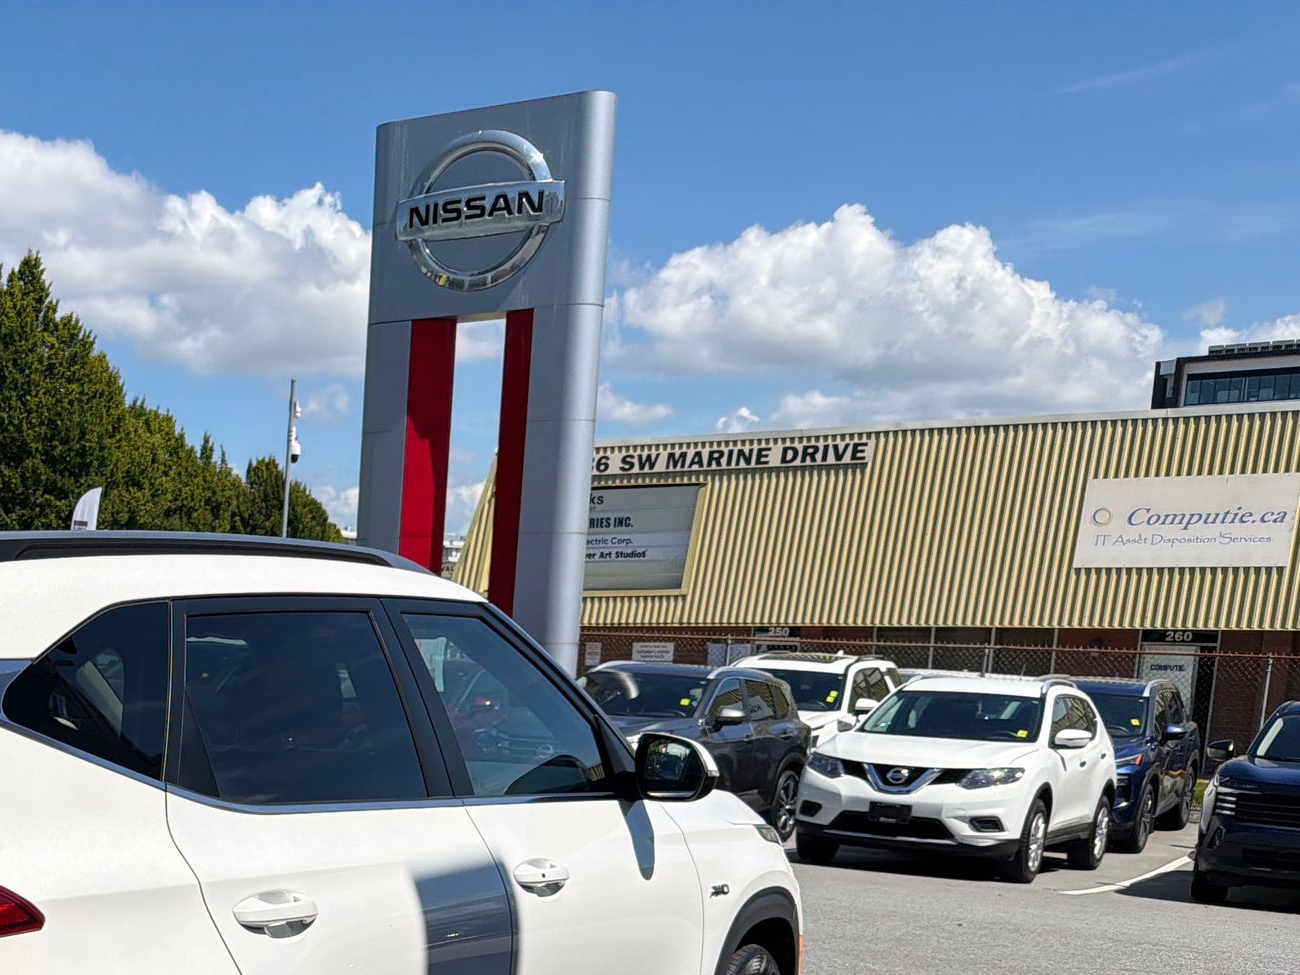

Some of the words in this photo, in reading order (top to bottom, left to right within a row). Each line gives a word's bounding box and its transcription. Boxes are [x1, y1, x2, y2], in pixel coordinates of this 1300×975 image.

[409, 189, 545, 229] NISSAN
[588, 455, 610, 473] 6
[619, 452, 661, 472] SW
[665, 447, 772, 470] MARINE
[780, 442, 869, 464] DRIVE
[613, 516, 634, 528] INC.
[1127, 506, 1288, 531] Computie.ca
[610, 537, 634, 546] Corp.
[1094, 534, 1111, 547] IT
[1112, 533, 1148, 546] Asset
[1150, 533, 1217, 548] Disposition
[1219, 531, 1273, 546] Services
[599, 551, 612, 560] Art
[615, 549, 646, 559] Studios
[768, 627, 790, 637] 250
[1165, 631, 1193, 641] 260
